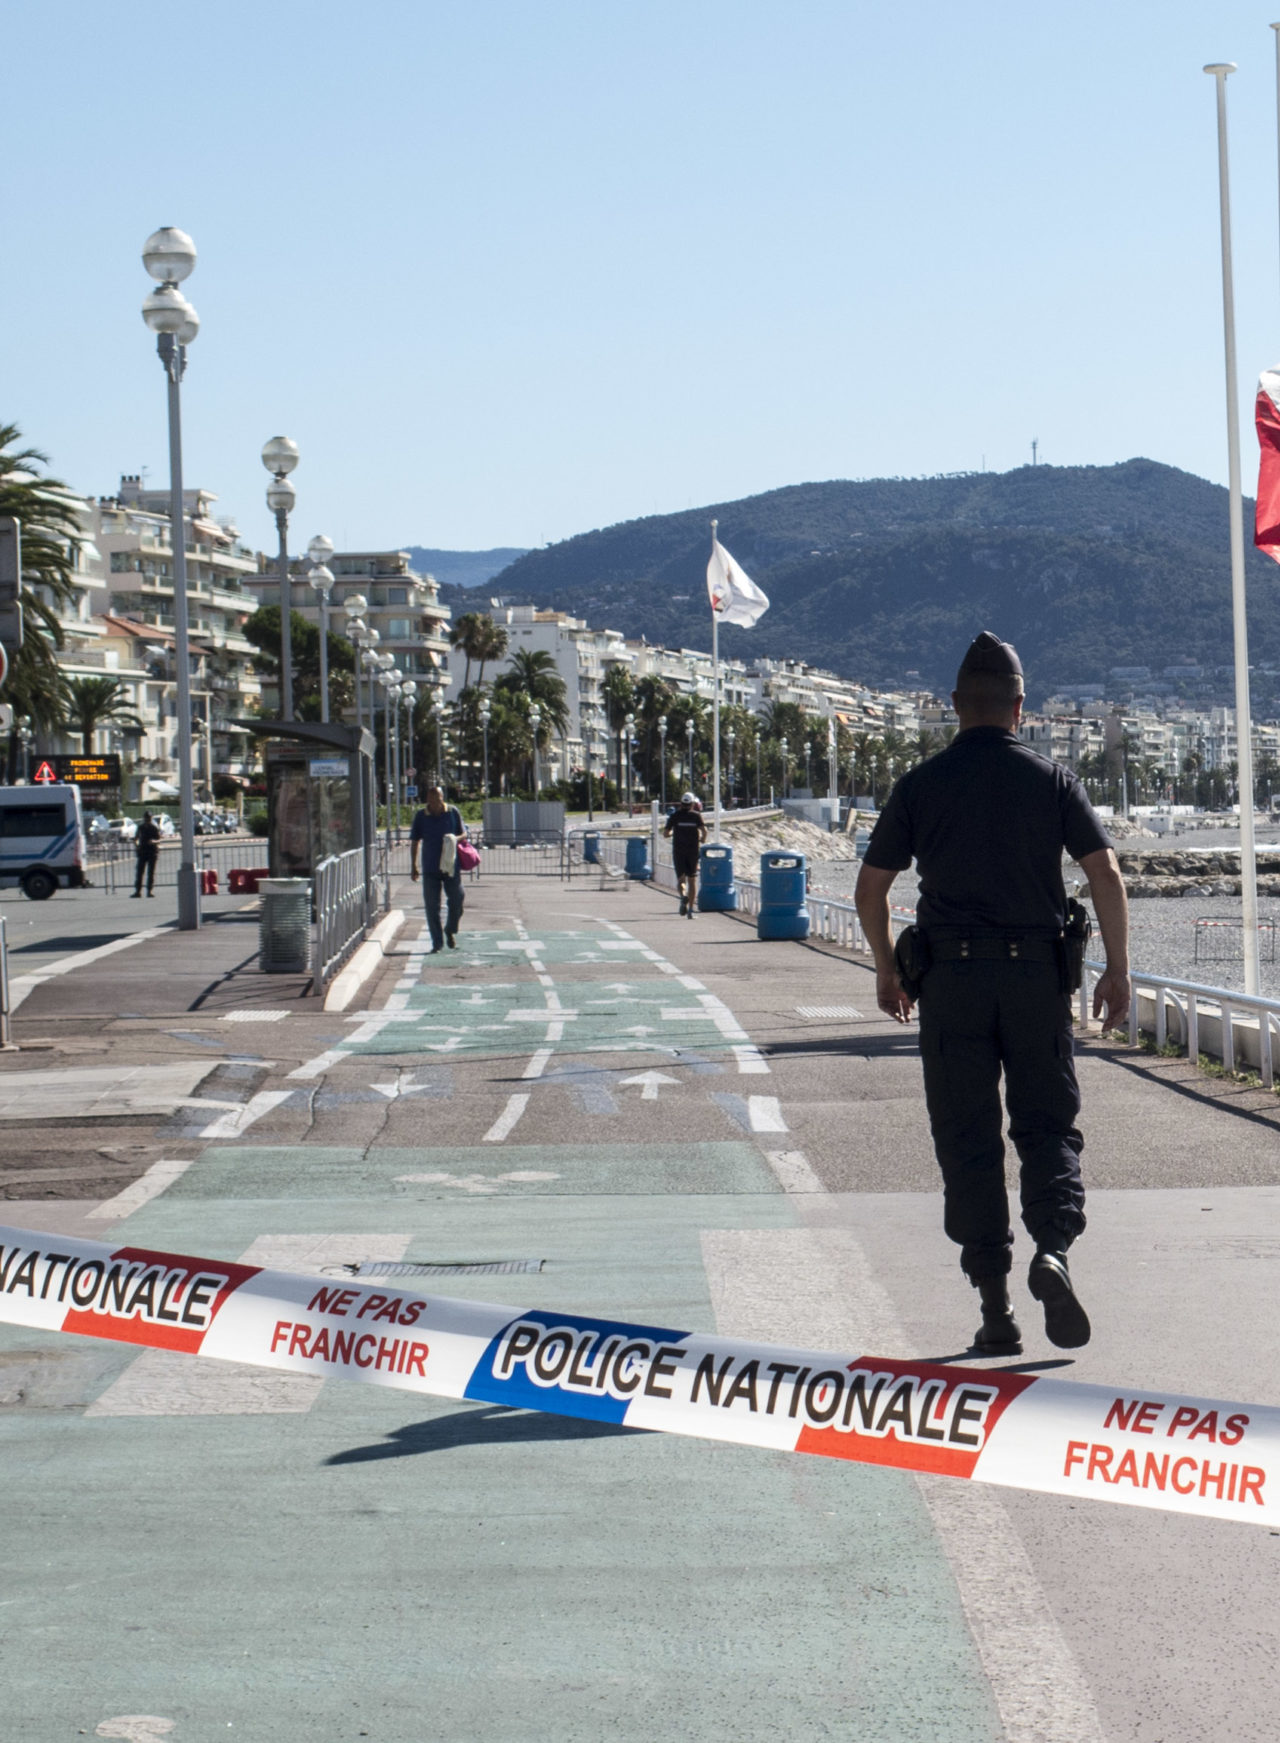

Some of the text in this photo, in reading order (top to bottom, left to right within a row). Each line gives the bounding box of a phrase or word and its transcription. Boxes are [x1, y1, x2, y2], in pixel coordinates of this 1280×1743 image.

[307, 1286, 427, 1326] NE PAS
[270, 1320, 429, 1377] FRANCHIR
[501, 1325, 992, 1445] POLICE NATIONALE
[1103, 1398, 1250, 1446] NE PAS
[1062, 1440, 1267, 1506] FRANCHIR
